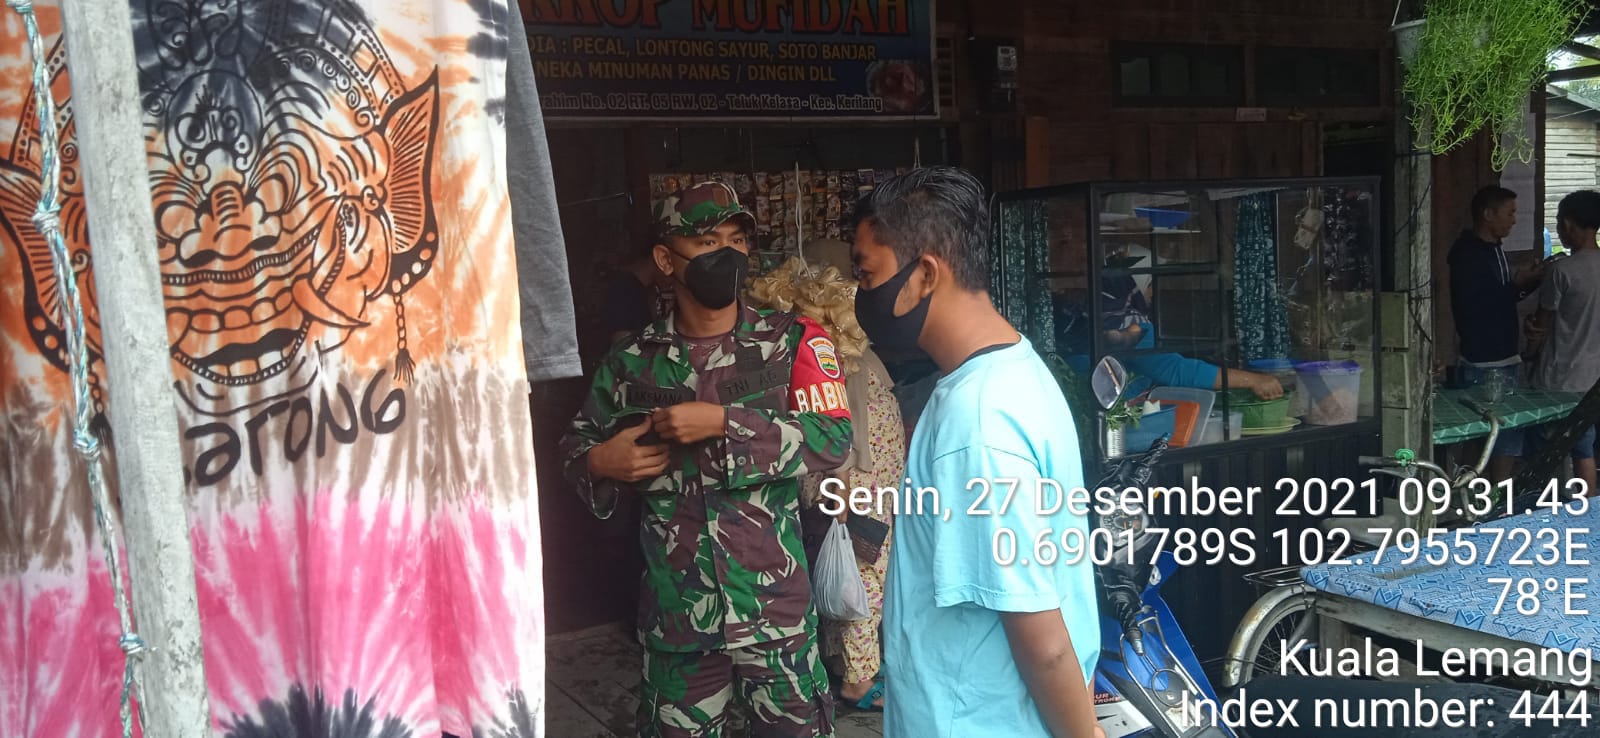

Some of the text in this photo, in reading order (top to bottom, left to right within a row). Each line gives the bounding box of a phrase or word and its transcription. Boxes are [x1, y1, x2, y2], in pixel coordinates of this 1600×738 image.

[573, 37, 631, 59] PECAL,
[636, 40, 715, 58] LONTONG
[718, 42, 774, 62] SAYUR,
[778, 43, 818, 60] SOTO
[822, 44, 876, 61] BANJAR
[588, 62, 673, 80] MINUMAN
[678, 64, 731, 81] PANAS
[747, 65, 805, 81] DINGIN
[809, 65, 837, 82] DLL
[607, 93, 627, 109] 02
[700, 94, 718, 110] 02
[722, 378, 750, 396] TNI
